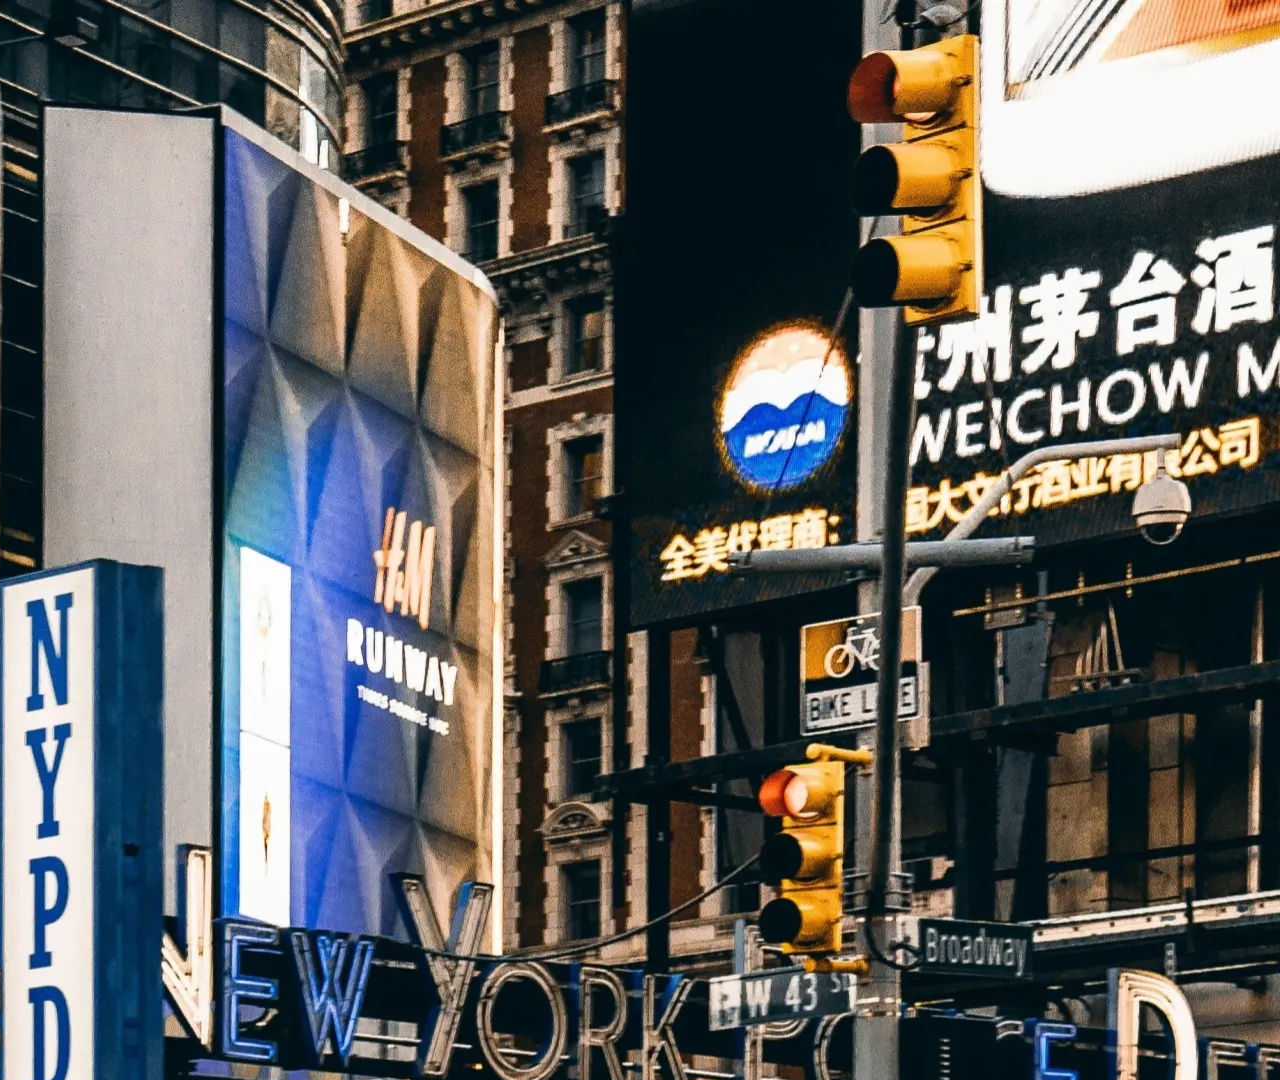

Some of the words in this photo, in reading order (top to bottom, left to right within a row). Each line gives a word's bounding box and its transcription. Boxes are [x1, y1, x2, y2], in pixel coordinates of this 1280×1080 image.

[913, 224, 1274, 400] 州茅台酒
[909, 352, 1210, 466] WEICHOW
[346, 617, 458, 706] RUNWAY
[809, 692, 852, 721] BIKE
[861, 682, 913, 713] LE
[161, 846, 377, 1067] NEW
[925, 927, 1028, 968] Broadway
[745, 978, 772, 1018] W
[784, 972, 818, 1012] 43
